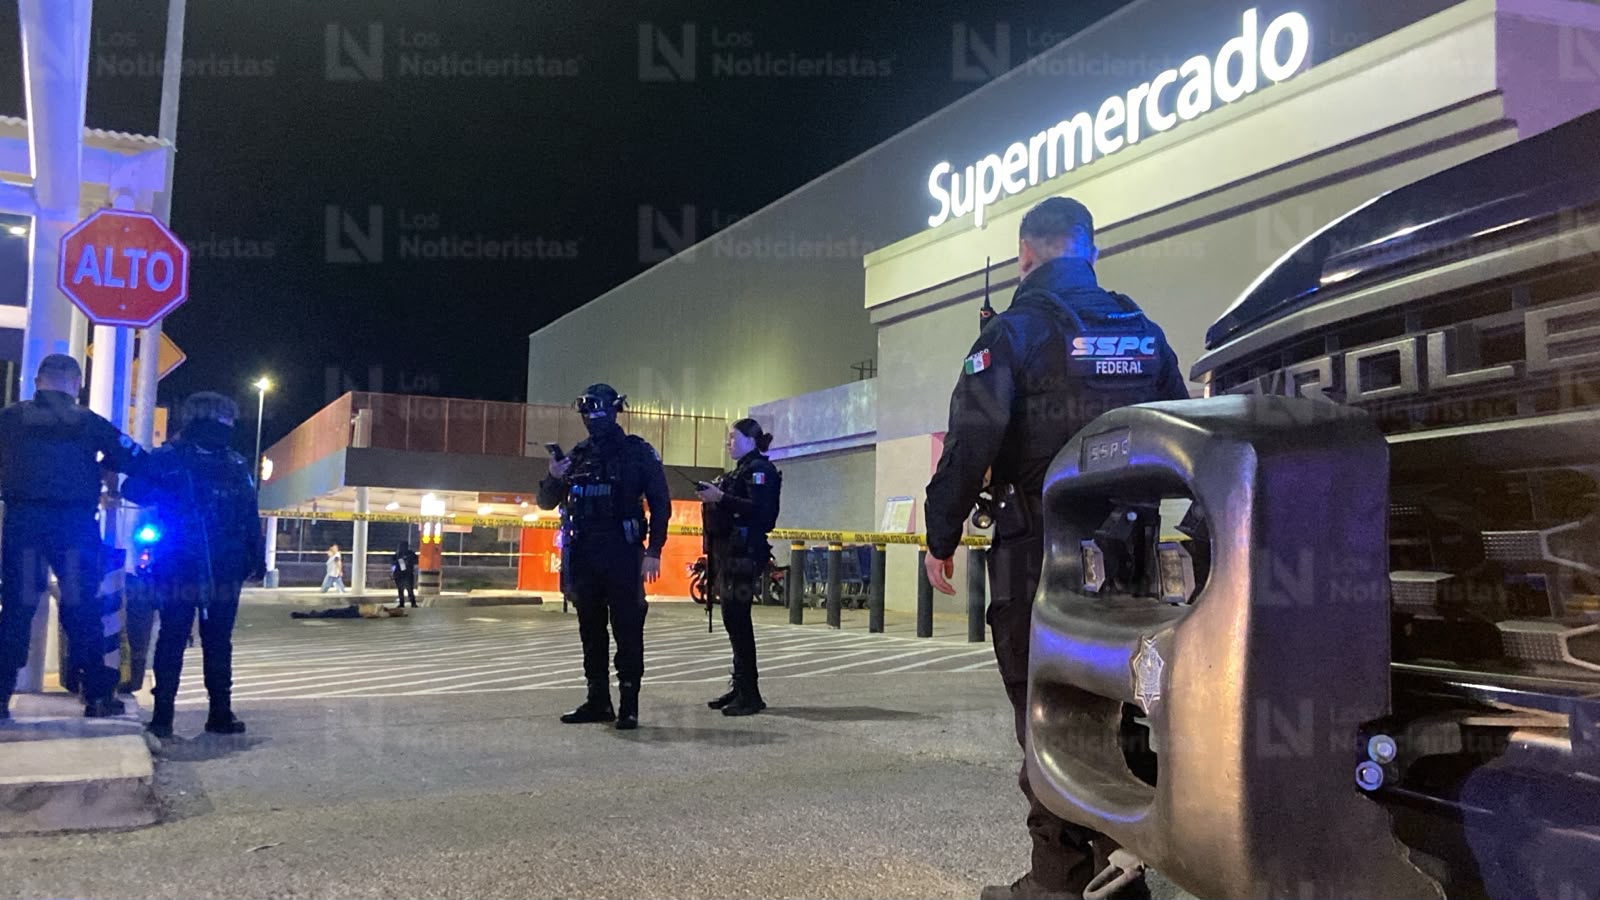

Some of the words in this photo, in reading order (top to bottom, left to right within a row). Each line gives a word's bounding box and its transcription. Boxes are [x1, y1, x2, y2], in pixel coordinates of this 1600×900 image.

[928, 8, 1309, 227] Supermercado
[72, 243, 174, 292] ALTO
[1071, 336, 1155, 356] SSPC
[1225, 297, 1600, 410] ROLE
[1096, 361, 1143, 374] FEDERAL
[1090, 439, 1128, 460] SSPC
